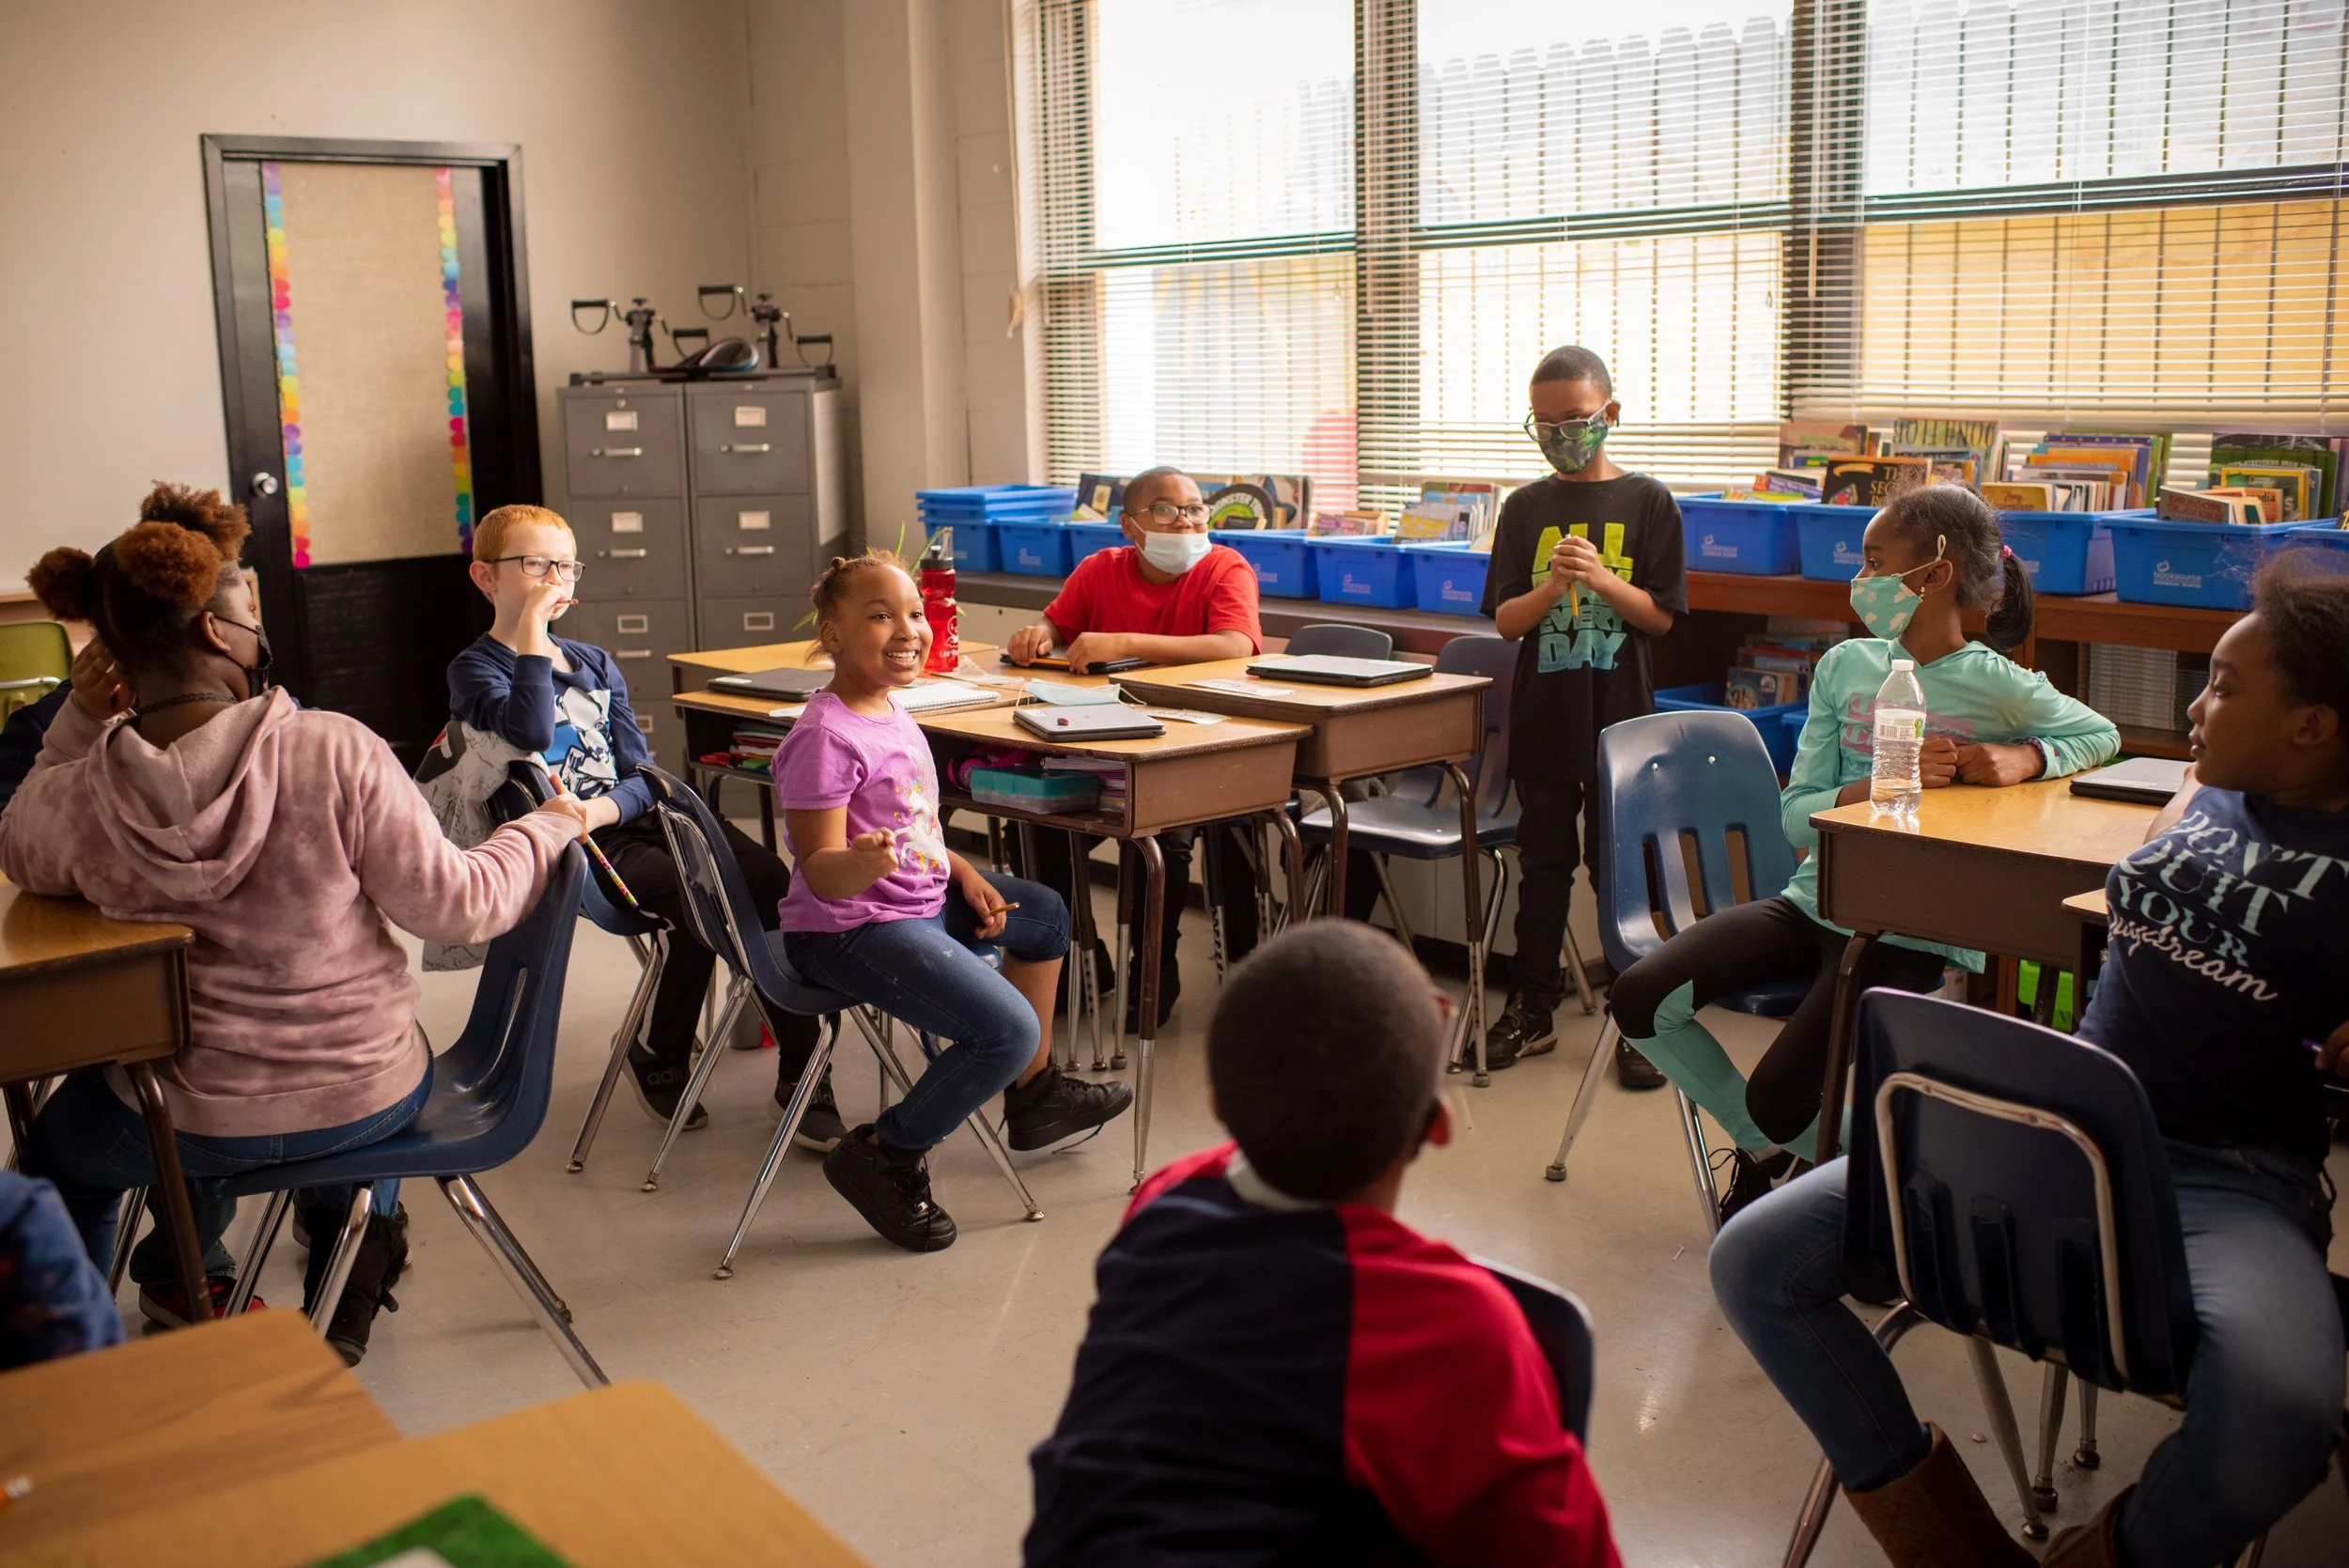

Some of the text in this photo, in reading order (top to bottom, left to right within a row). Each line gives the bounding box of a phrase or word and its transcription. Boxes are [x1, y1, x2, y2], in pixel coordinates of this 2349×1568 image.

[2118, 875, 2248, 967] YOUR
[2119, 837, 2289, 937] QUIT
[646, 1066, 689, 1086] adid
